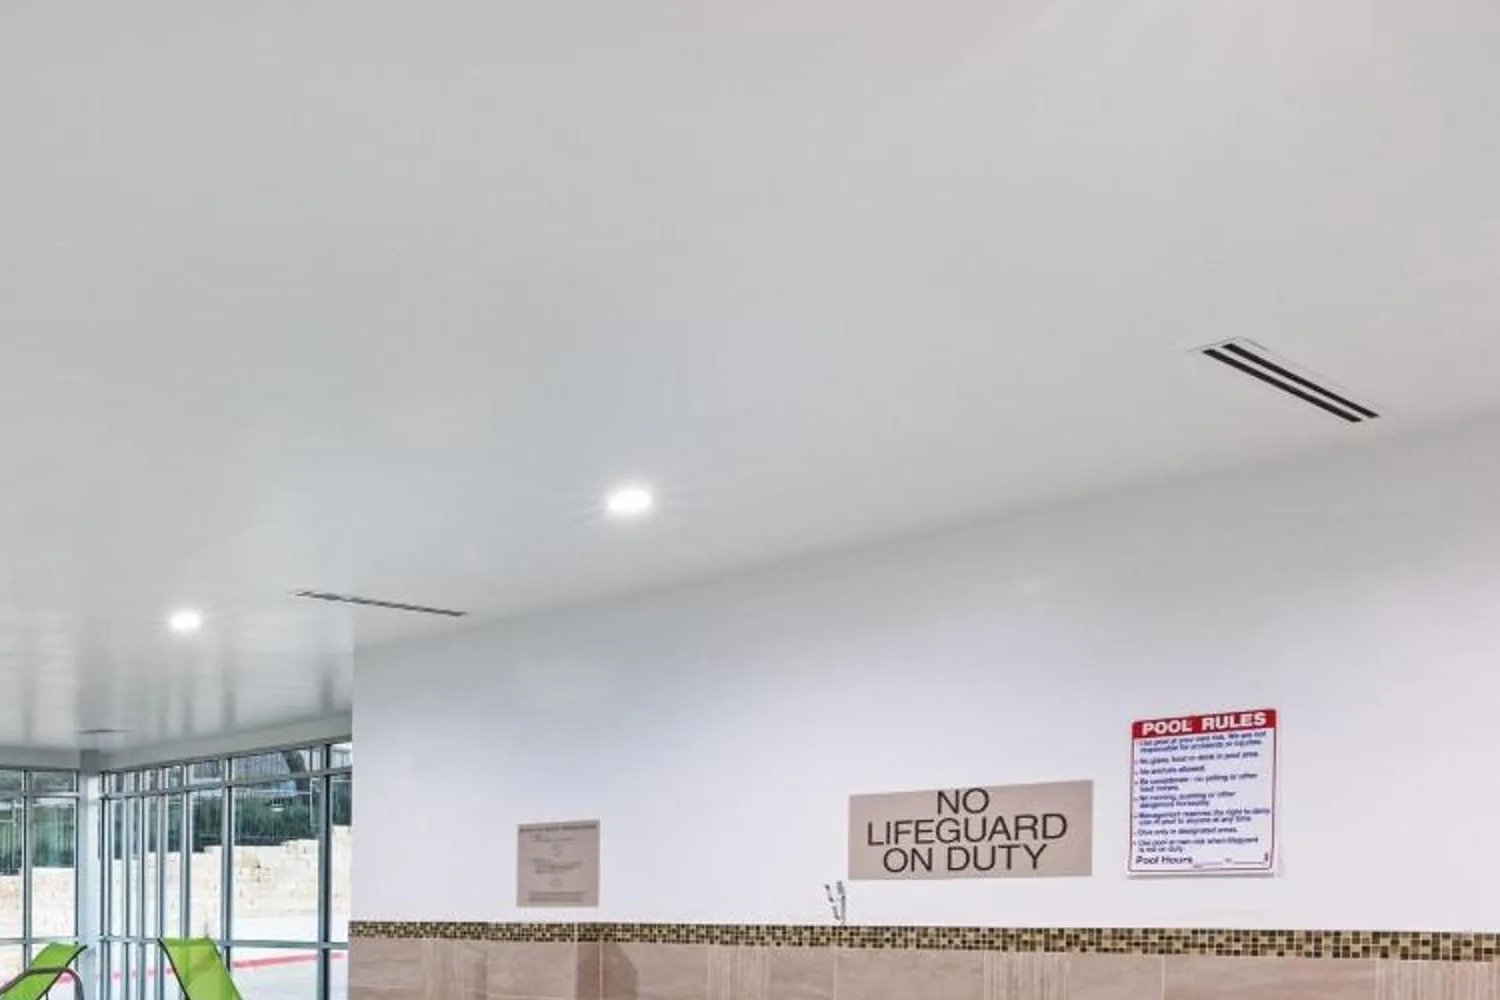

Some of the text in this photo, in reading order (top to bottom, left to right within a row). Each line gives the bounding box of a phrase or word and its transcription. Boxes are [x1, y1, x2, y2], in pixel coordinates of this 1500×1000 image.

[1142, 711, 1266, 736] POOL RULES
[937, 787, 990, 815] NO
[867, 813, 1068, 846] LIFEGUARD
[883, 843, 1047, 873] ON DUTY
[1135, 855, 1193, 865] Pool Hours
